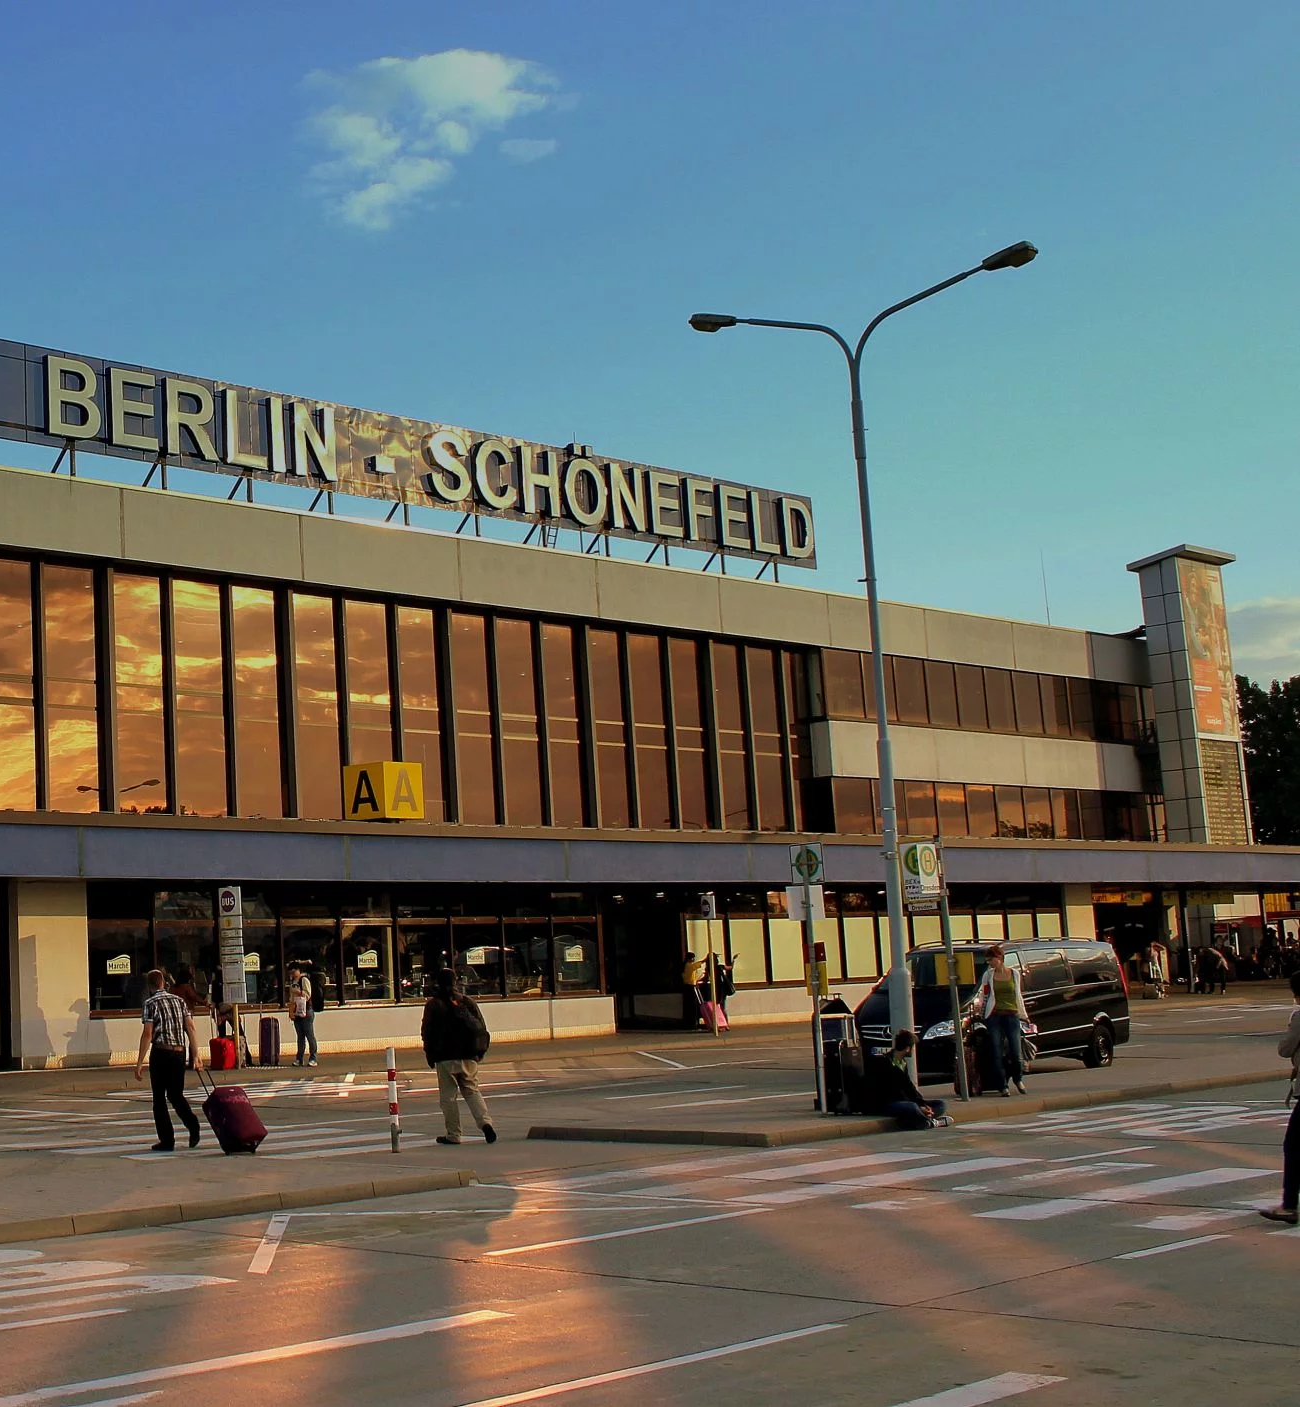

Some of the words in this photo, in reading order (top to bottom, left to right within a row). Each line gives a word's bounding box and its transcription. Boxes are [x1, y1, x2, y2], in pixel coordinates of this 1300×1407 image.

[43, 354, 338, 482] BERLIN
[424, 429, 816, 560] SCHÖNEFELD
[351, 769, 380, 815] A
[391, 766, 419, 812] A
[220, 896, 235, 907] BUS
[358, 956, 377, 965] Marché
[467, 953, 484, 962] Marché
[108, 961, 130, 970] Marché
[244, 959, 259, 967] arché
